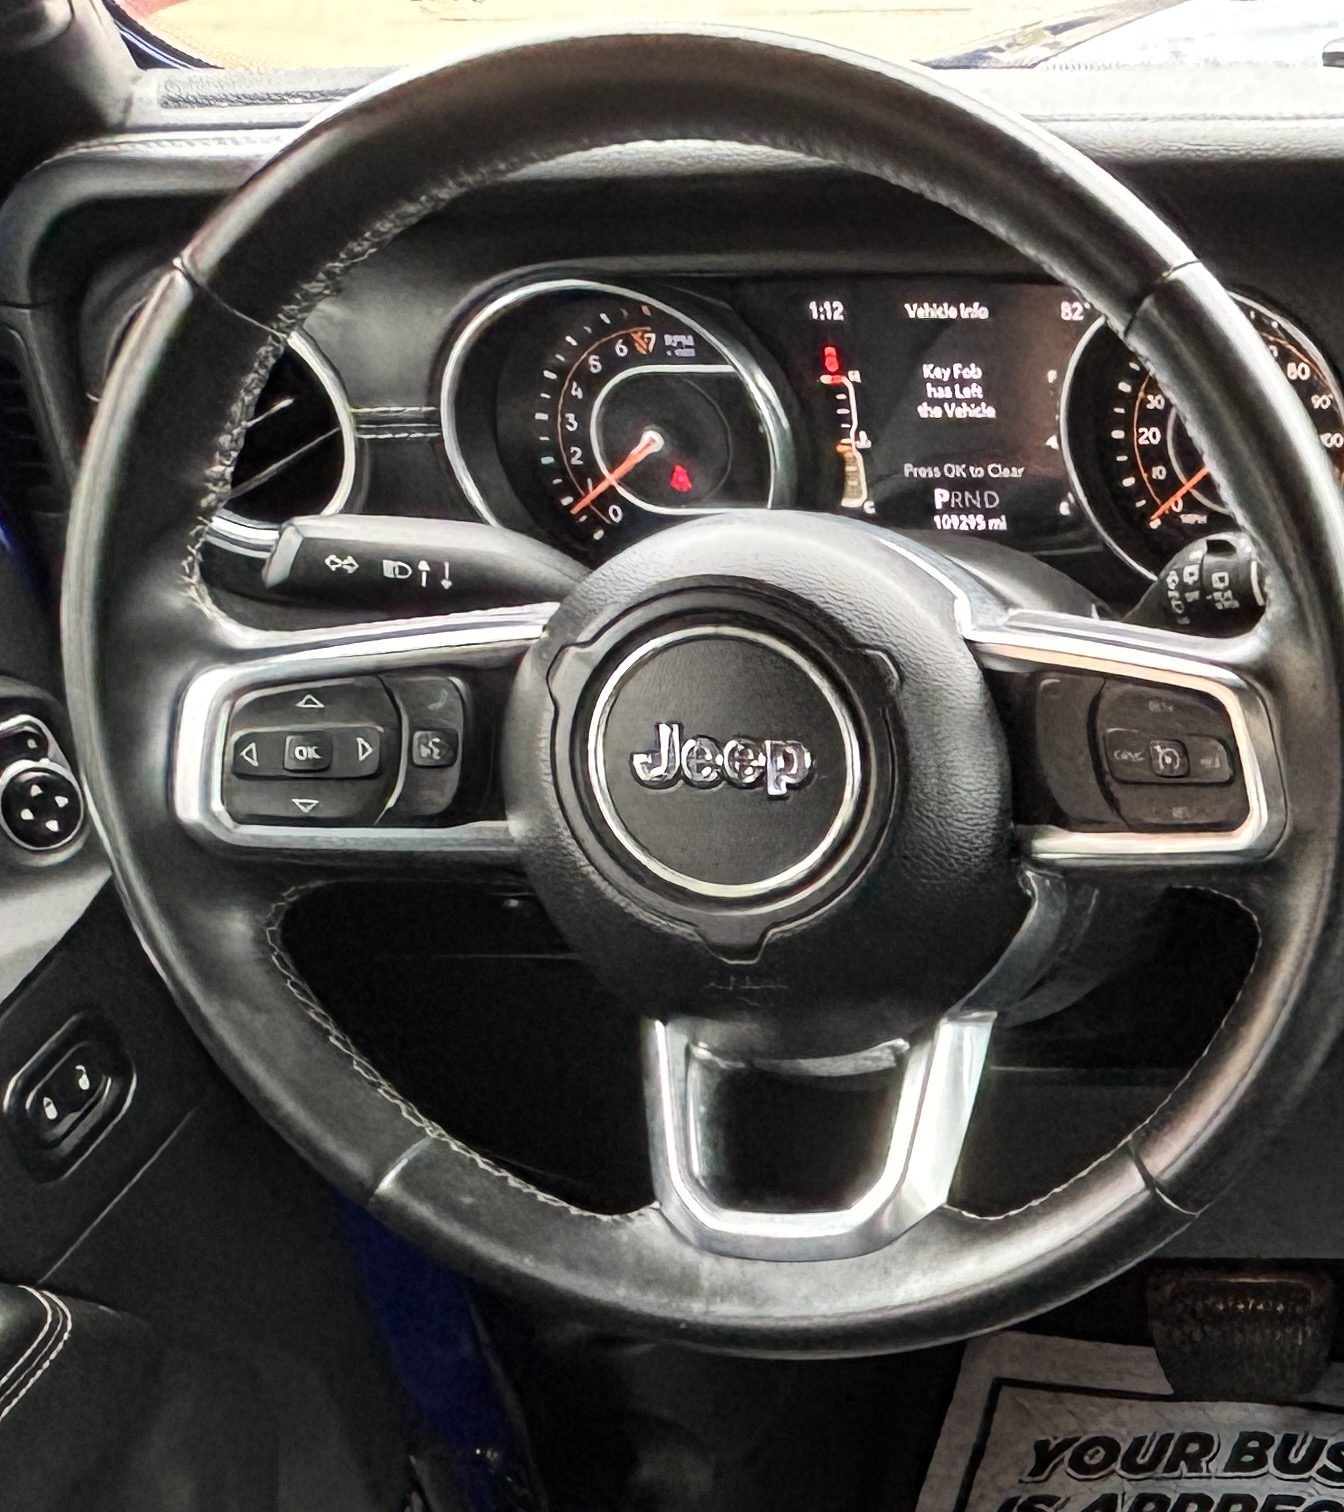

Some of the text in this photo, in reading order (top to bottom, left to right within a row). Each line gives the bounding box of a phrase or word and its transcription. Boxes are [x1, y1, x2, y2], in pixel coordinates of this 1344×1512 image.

[809, 300, 844, 321] 1:12
[904, 303, 957, 319] Vehicle
[615, 338, 628, 357] 6
[643, 332, 656, 352] 7
[588, 354, 602, 374] 5
[922, 363, 982, 383] Key Fob
[1286, 362, 1310, 380] 80
[571, 382, 584, 400] 4
[926, 383, 984, 399] has Left
[917, 402, 996, 418] the Vehicle
[1145, 394, 1165, 409] 30
[565, 413, 578, 431] 3
[1137, 427, 1161, 444] 20
[570, 447, 584, 465] 2
[904, 463, 1025, 478] Press OK to Clear
[608, 504, 623, 523] 0
[988, 514, 1007, 530] mi
[294, 745, 323, 761] OK
[632, 722, 814, 797] Jeep
[1019, 1430, 1221, 1483] YOUR
